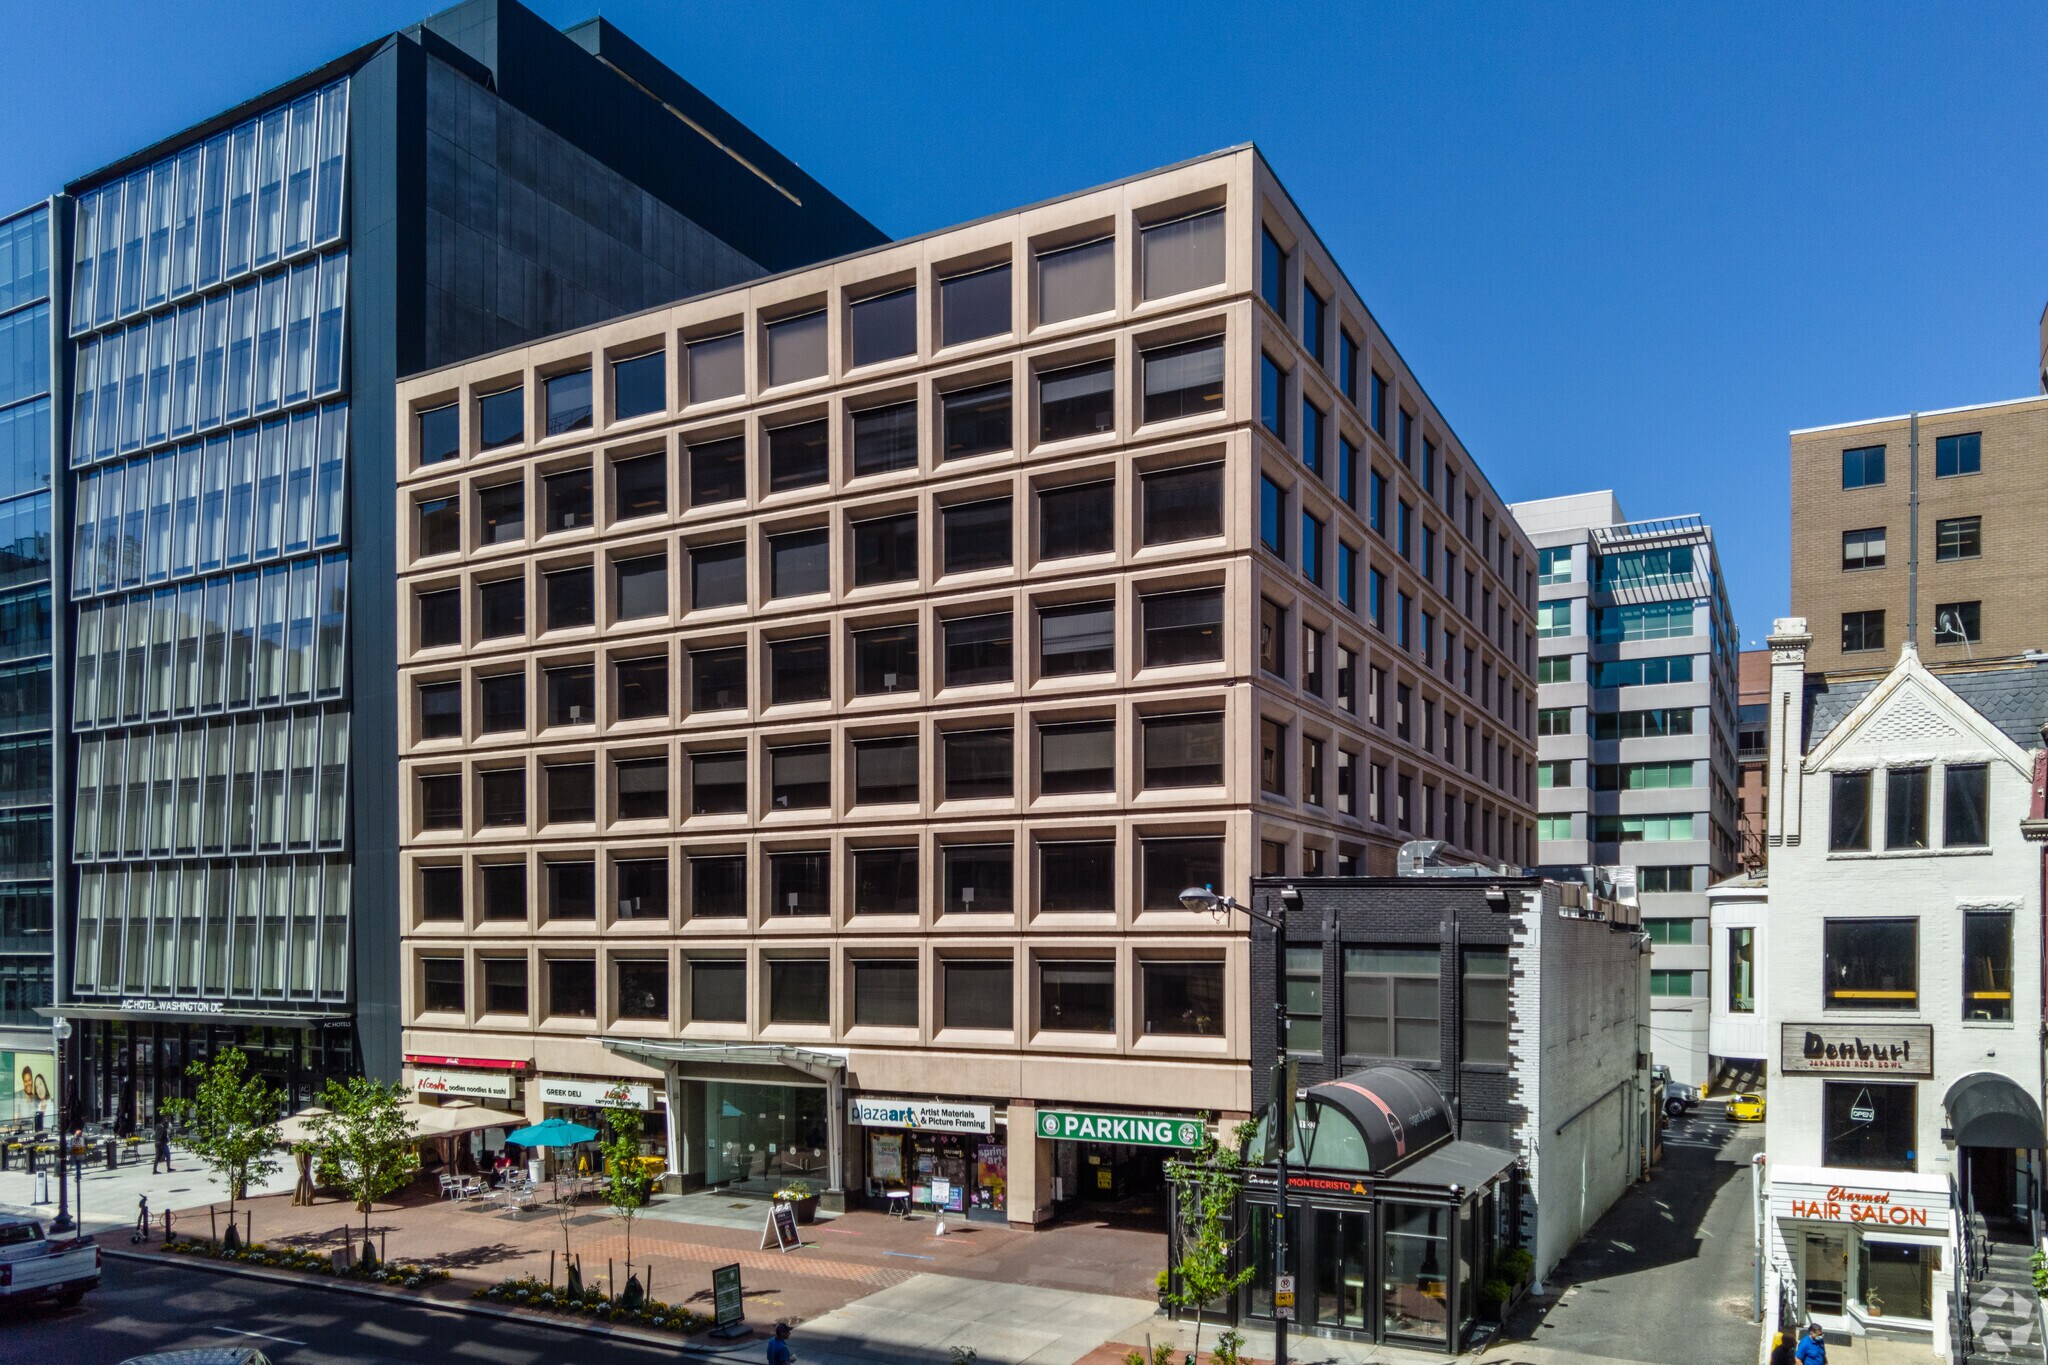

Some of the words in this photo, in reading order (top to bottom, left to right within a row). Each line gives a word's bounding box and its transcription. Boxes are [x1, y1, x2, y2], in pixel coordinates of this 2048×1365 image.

[121, 1000, 133, 1009] AC
[134, 1000, 157, 1010] HOTEL
[158, 1001, 209, 1012] WASHINGTON
[210, 1003, 224, 1012] DC
[1804, 1031, 1910, 1062] Donburi
[1809, 1060, 1851, 1068] JAPANESE
[1878, 1061, 1903, 1069] BOWL
[418, 1076, 448, 1092] Nooshi
[466, 1085, 486, 1094] noodles
[546, 1088, 566, 1096] GREEK
[568, 1090, 582, 1098] DELI
[920, 1108, 939, 1116] Artist
[942, 1109, 975, 1118] Materials
[928, 1118, 954, 1126] Picture
[956, 1119, 986, 1129] Framing
[1064, 1116, 1172, 1142] PARKING
[978, 1146, 1006, 1158] spring
[988, 1156, 1002, 1164] art
[1288, 1178, 1350, 1190] MONTECRISTO
[1826, 1185, 1890, 1204] Charmed
[1792, 1200, 1841, 1220] HAIR
[1850, 1204, 1927, 1226] SALON
